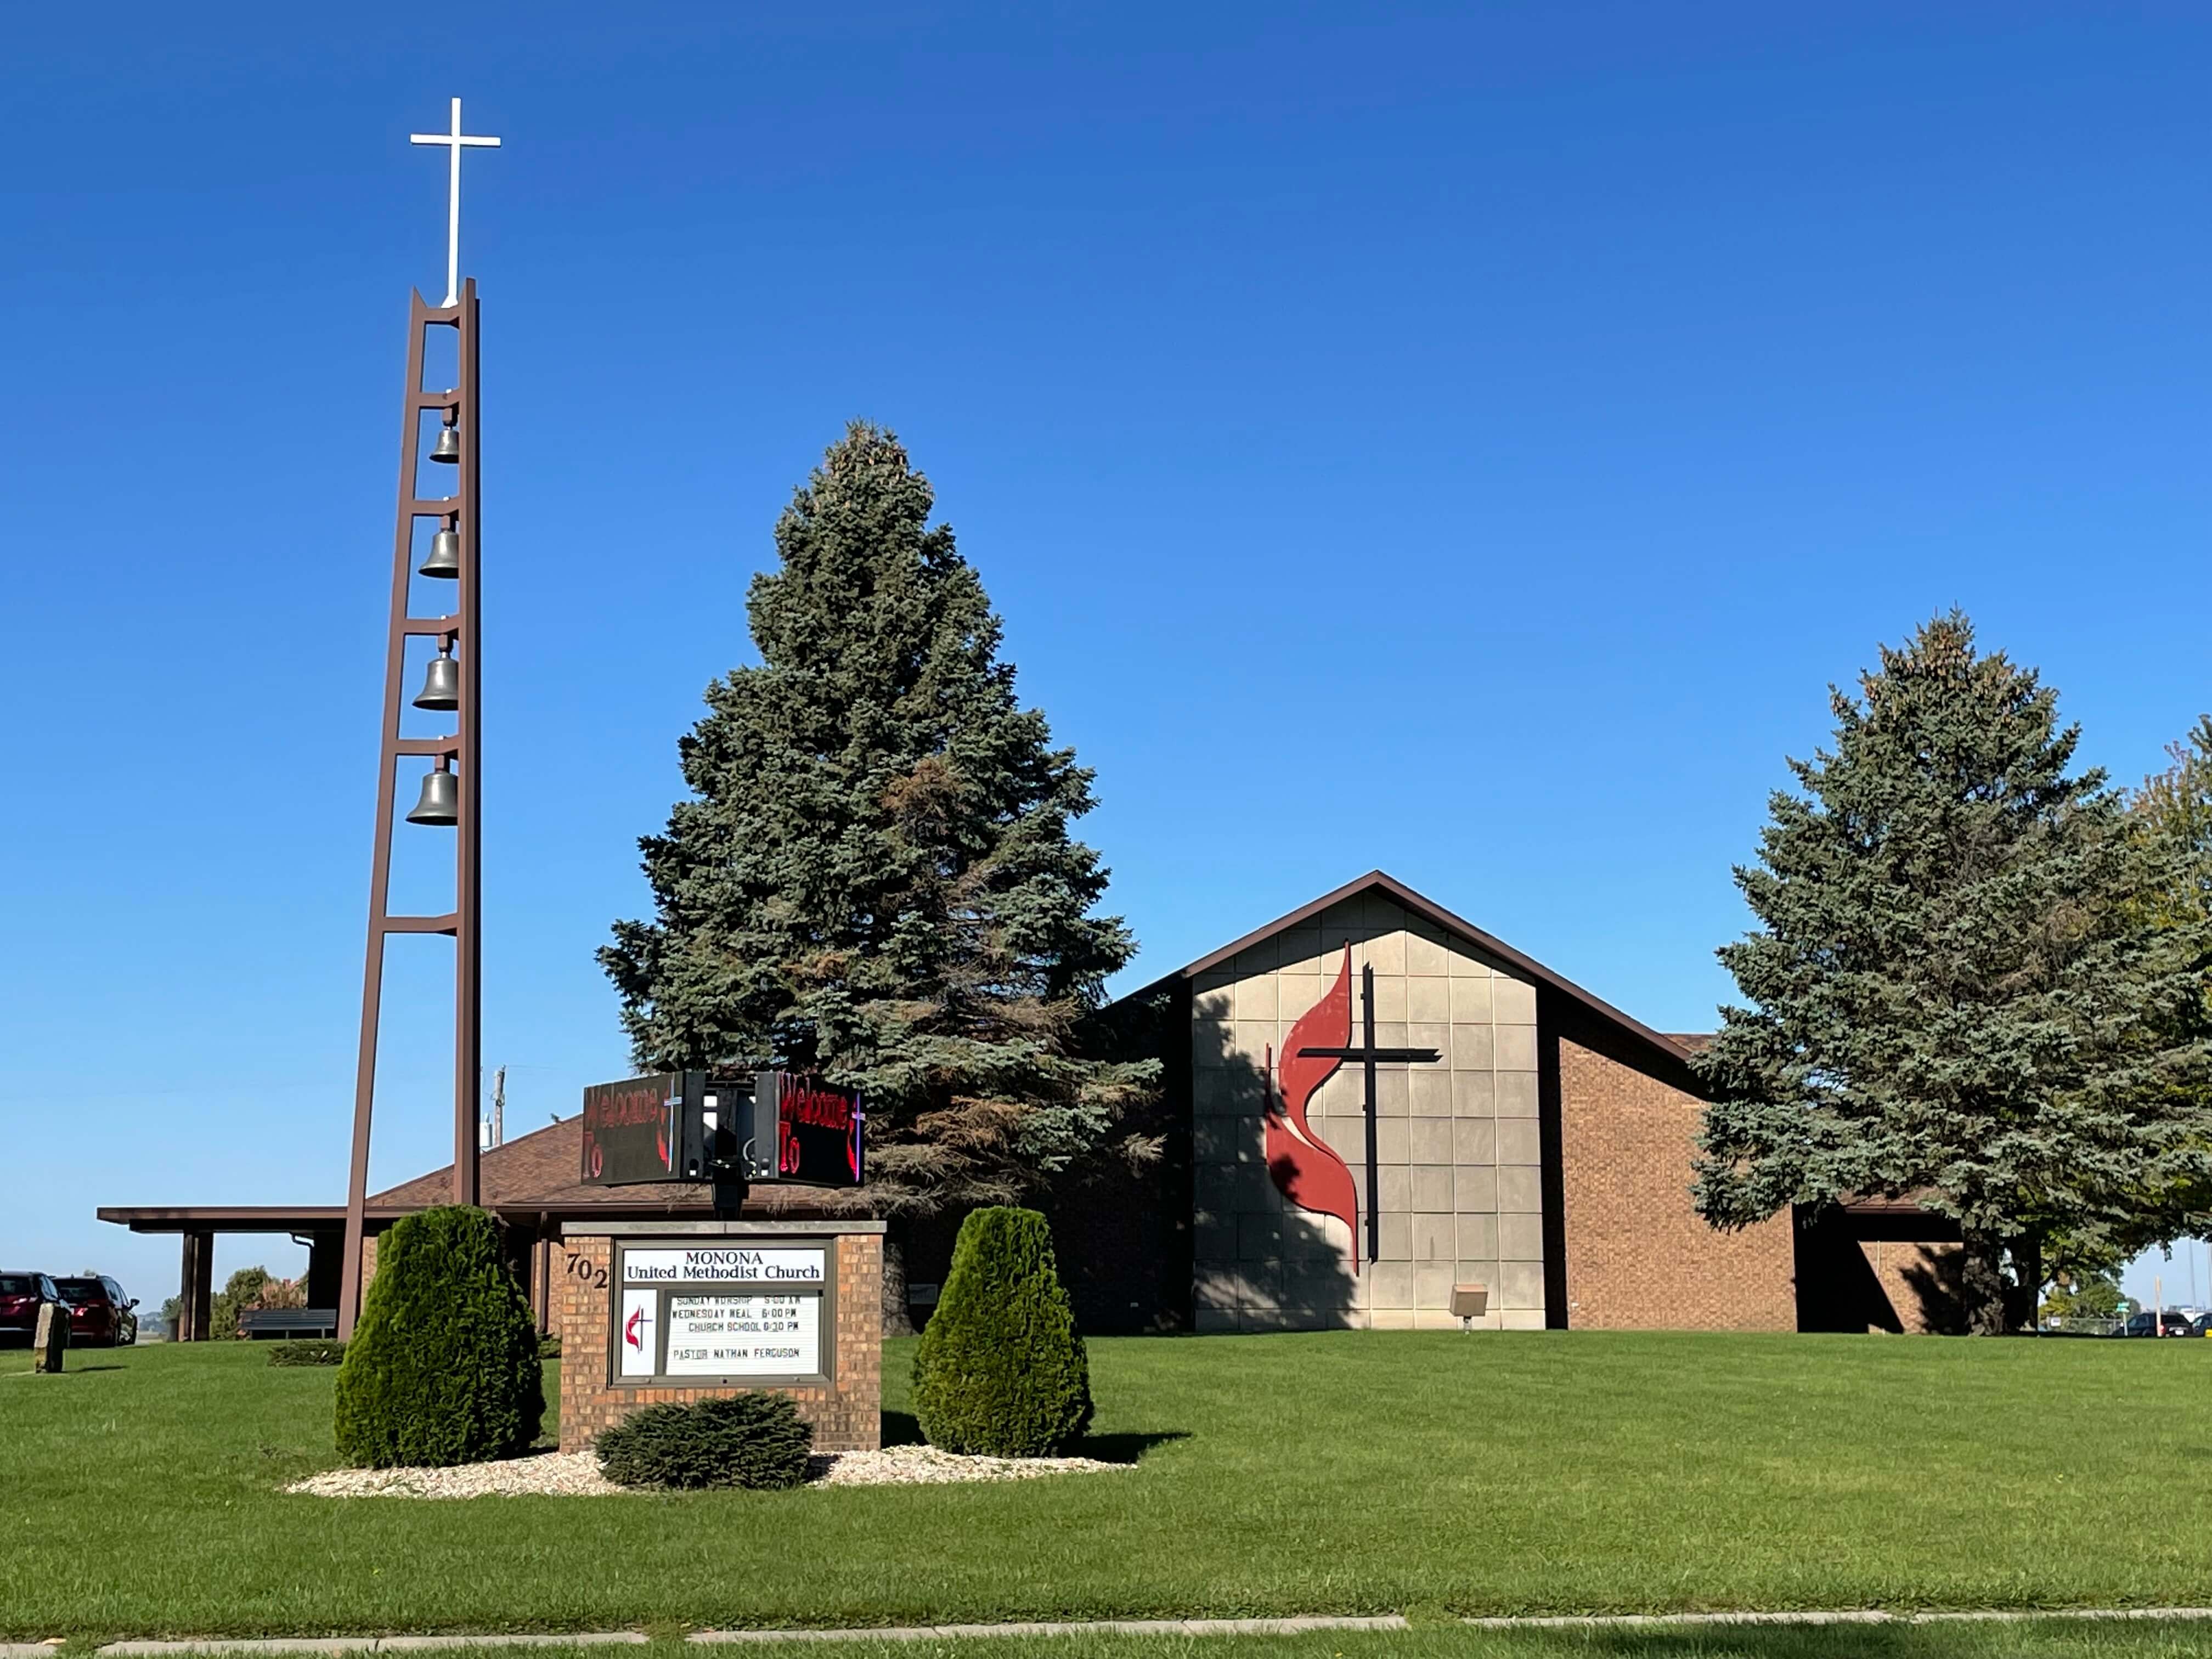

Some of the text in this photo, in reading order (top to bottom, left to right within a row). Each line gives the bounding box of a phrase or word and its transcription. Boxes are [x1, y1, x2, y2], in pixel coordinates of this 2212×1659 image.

[584, 1085, 658, 1128] Welcome
[779, 1073, 847, 1130] Welcome
[583, 1131, 603, 1178] To
[779, 1120, 800, 1174] To
[686, 1251, 763, 1265] MONONA
[567, 1253, 608, 1289] 702
[628, 1265, 820, 1279] United Methodist Church
[672, 1308, 797, 1318] WEDNESDAY MEAL 6:00 PM
[689, 1322, 724, 1332] CHURCH
[727, 1321, 761, 1332] SCHOOL
[787, 1321, 799, 1331] PM
[674, 1347, 800, 1359] PASTOR NATHAN FERGUSON
